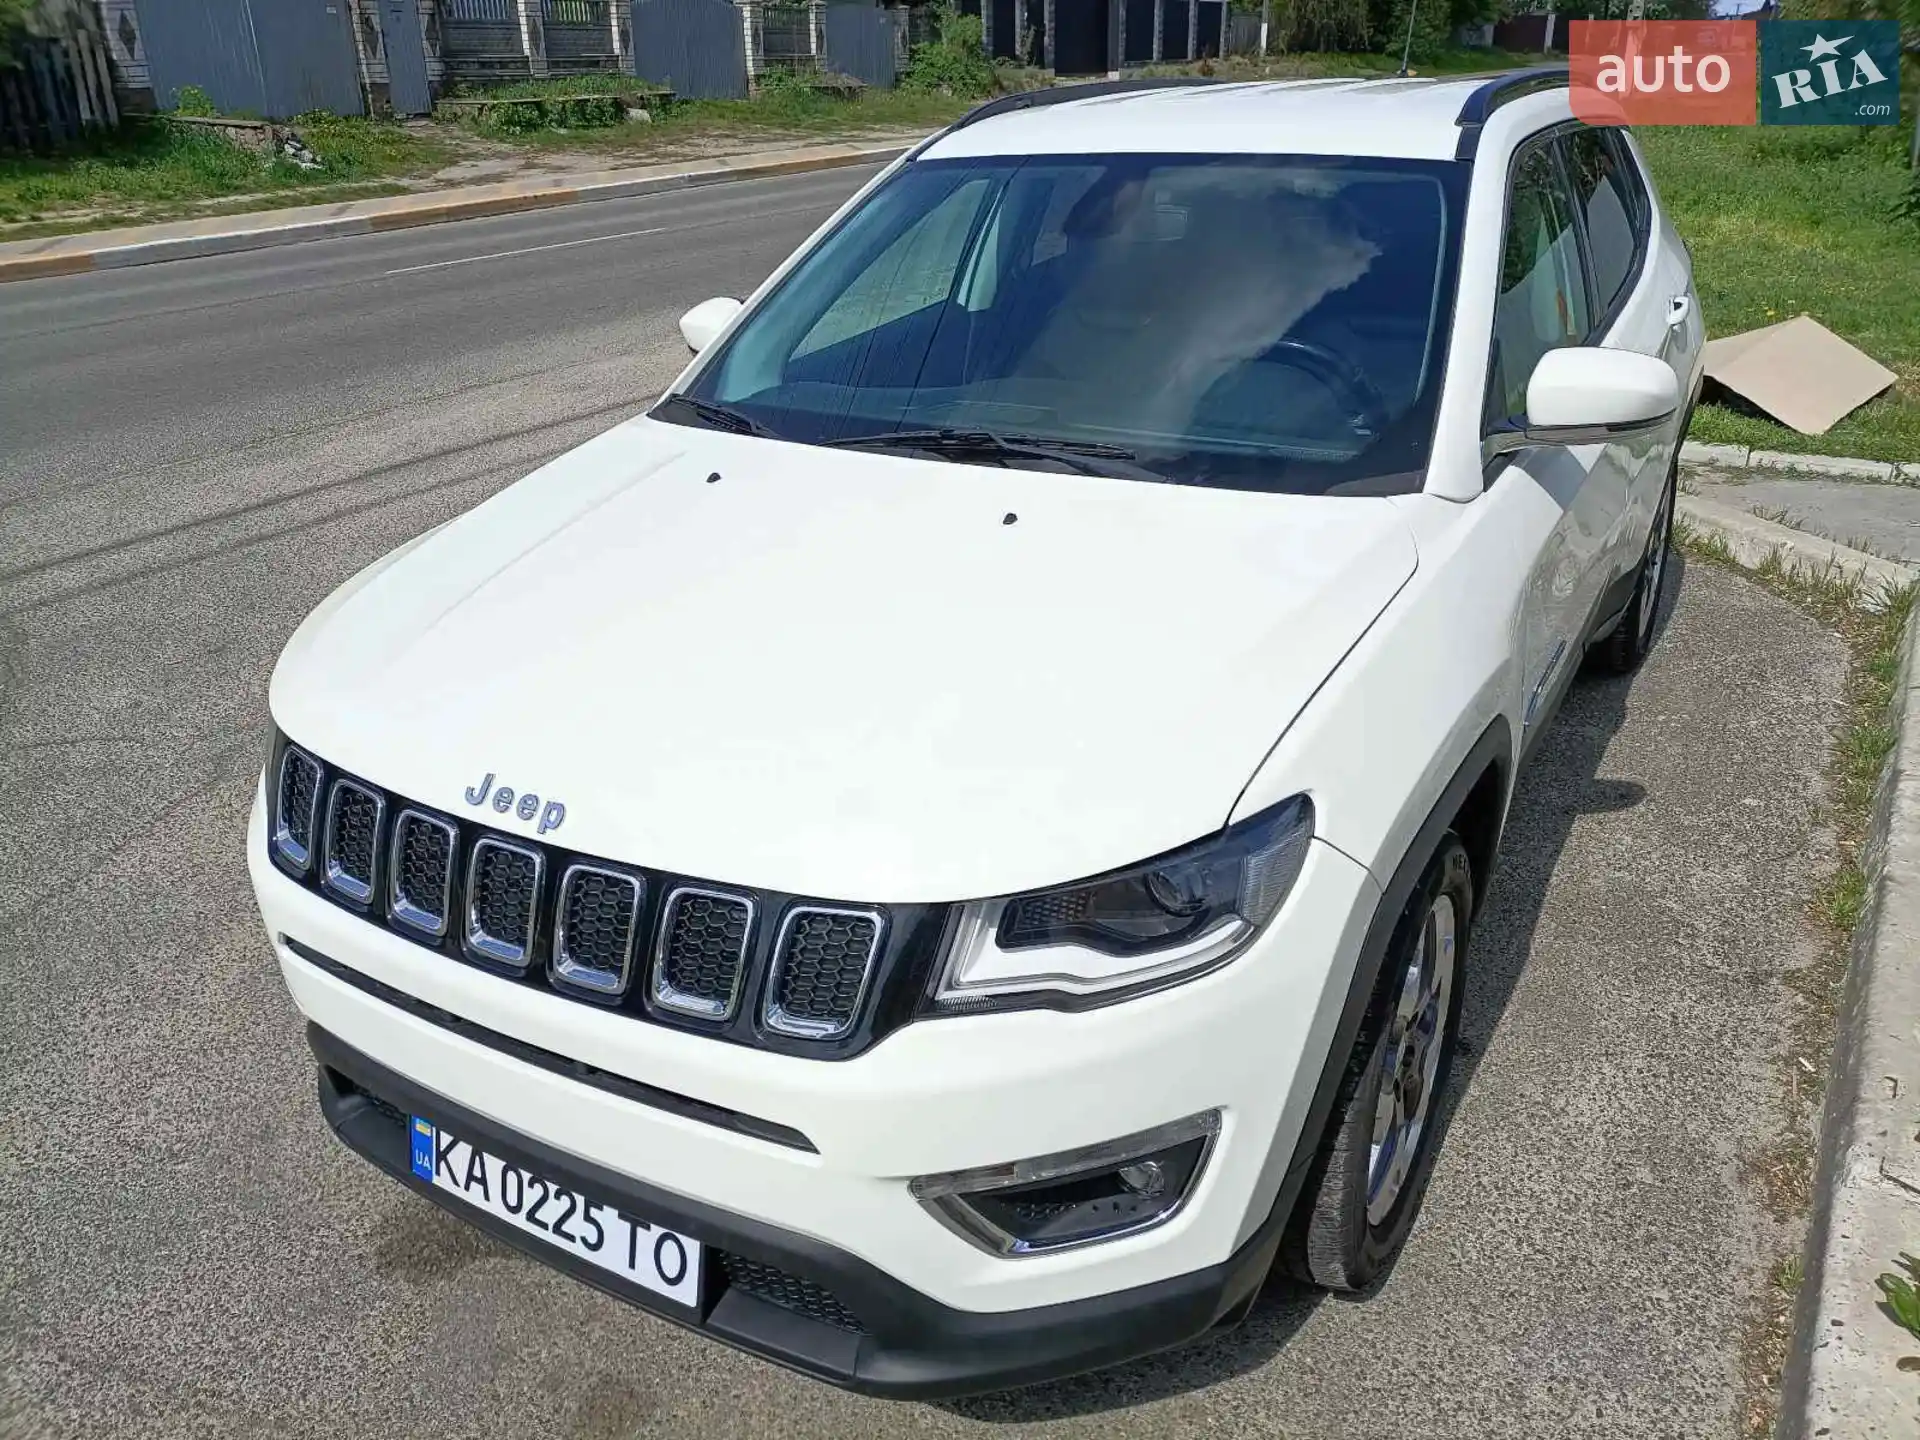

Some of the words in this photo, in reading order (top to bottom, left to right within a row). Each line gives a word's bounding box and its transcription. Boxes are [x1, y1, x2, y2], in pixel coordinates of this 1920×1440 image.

[465, 773, 566, 834] Jeep
[415, 1149, 432, 1170] UA
[435, 1130, 490, 1202] KA
[501, 1163, 604, 1251] 0225
[617, 1209, 688, 1286] TO
